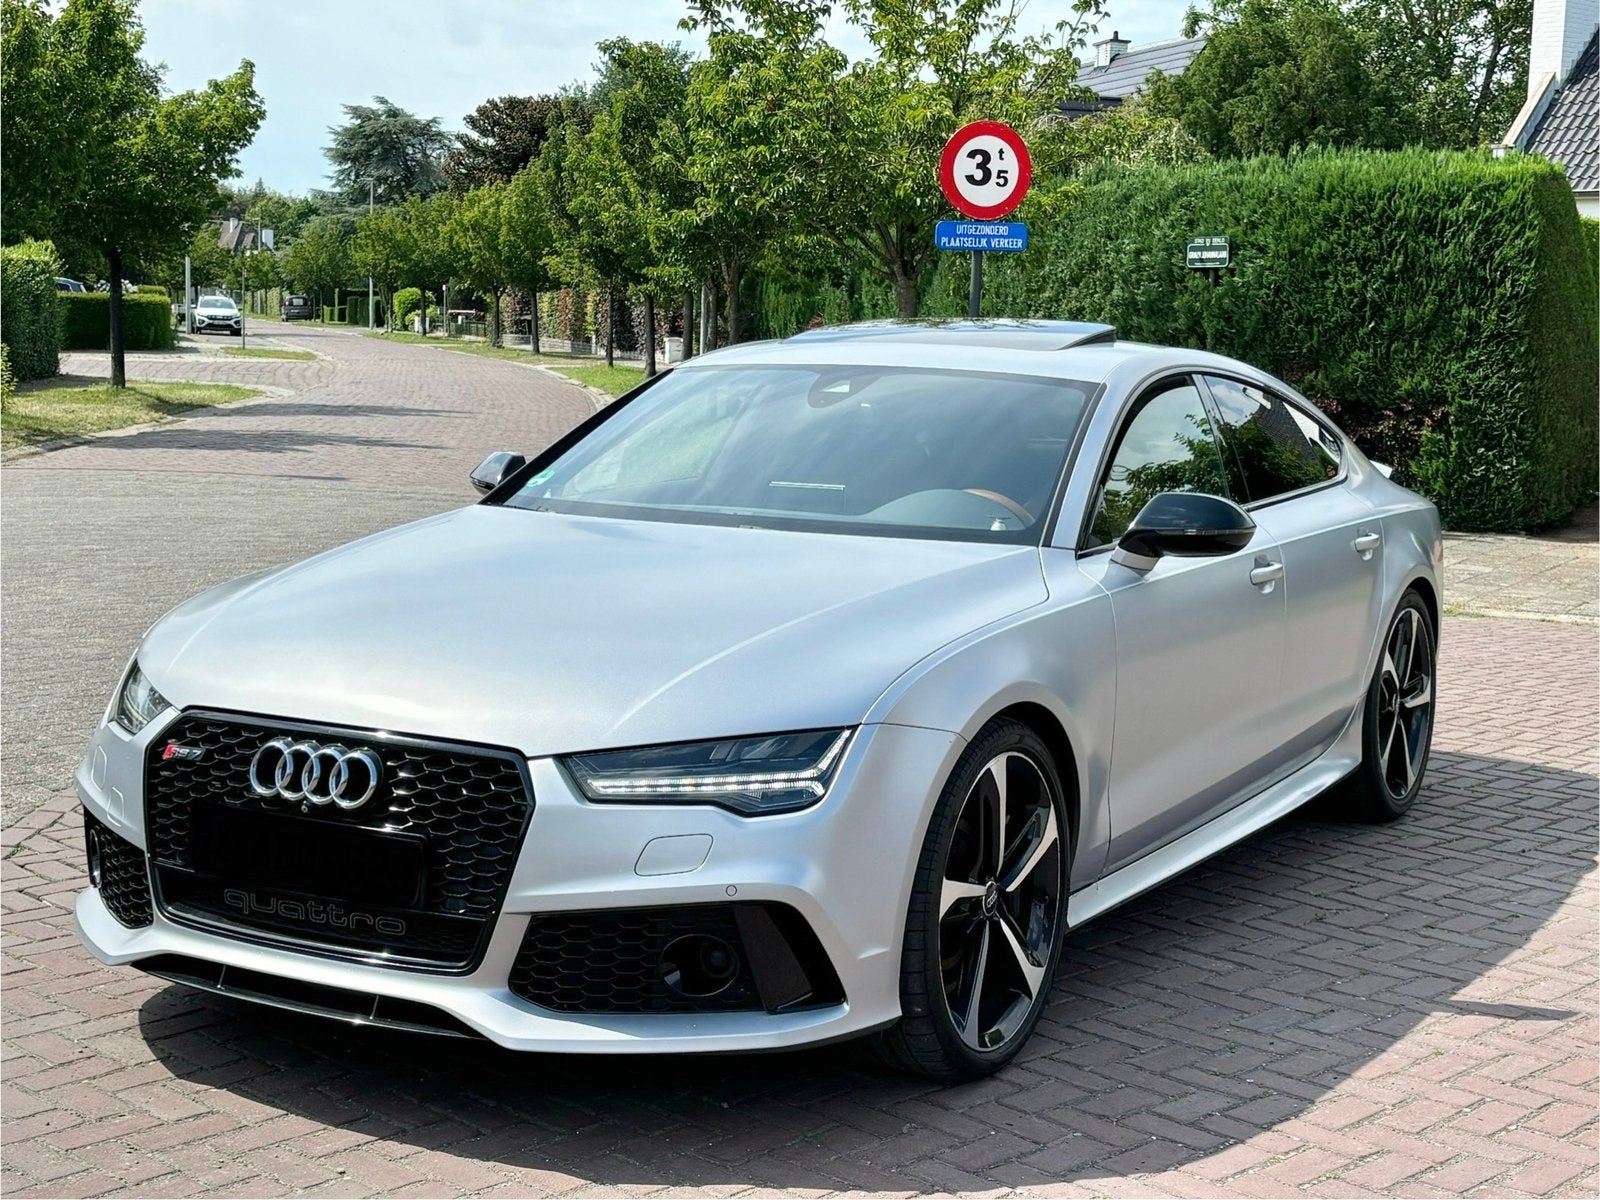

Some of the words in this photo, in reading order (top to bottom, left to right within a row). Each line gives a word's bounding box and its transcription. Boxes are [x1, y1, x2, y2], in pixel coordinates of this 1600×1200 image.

[956, 224, 1009, 235] UITGEZONDERD
[941, 237, 988, 248] PLAATSELIJK
[991, 238, 1023, 249] VERKEER
[223, 888, 406, 936] quattro
